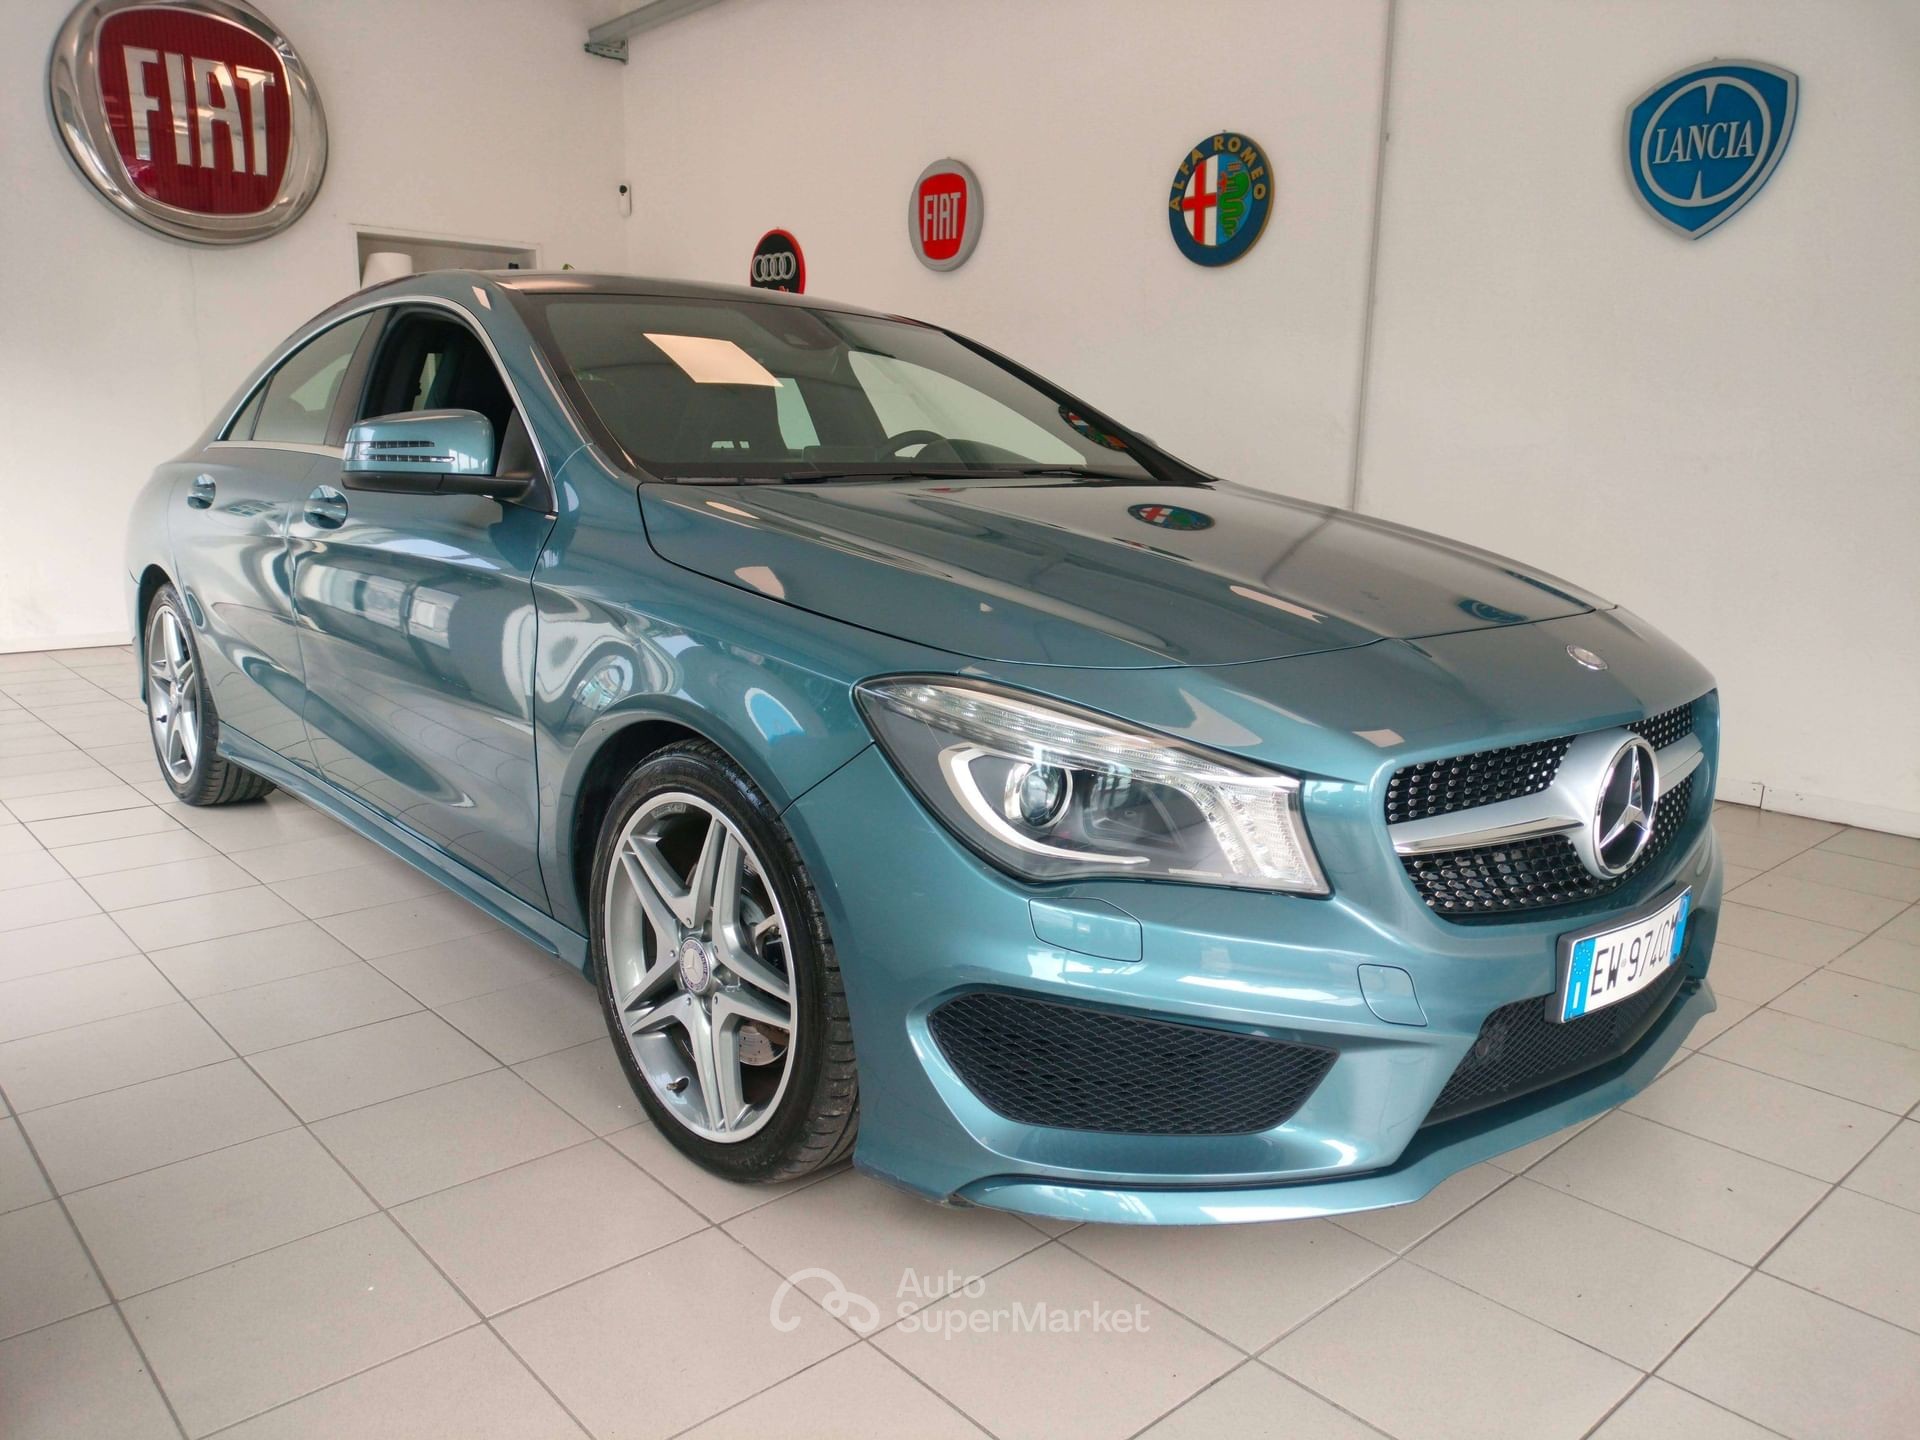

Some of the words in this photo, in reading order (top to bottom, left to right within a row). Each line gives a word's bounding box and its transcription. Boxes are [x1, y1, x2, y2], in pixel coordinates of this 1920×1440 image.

[122, 45, 275, 176] FIAT
[1652, 119, 1755, 165] LANCIA
[1169, 148, 1204, 211] ALFA
[1212, 135, 1267, 201] ROMEO
[923, 191, 962, 243] FIAT
